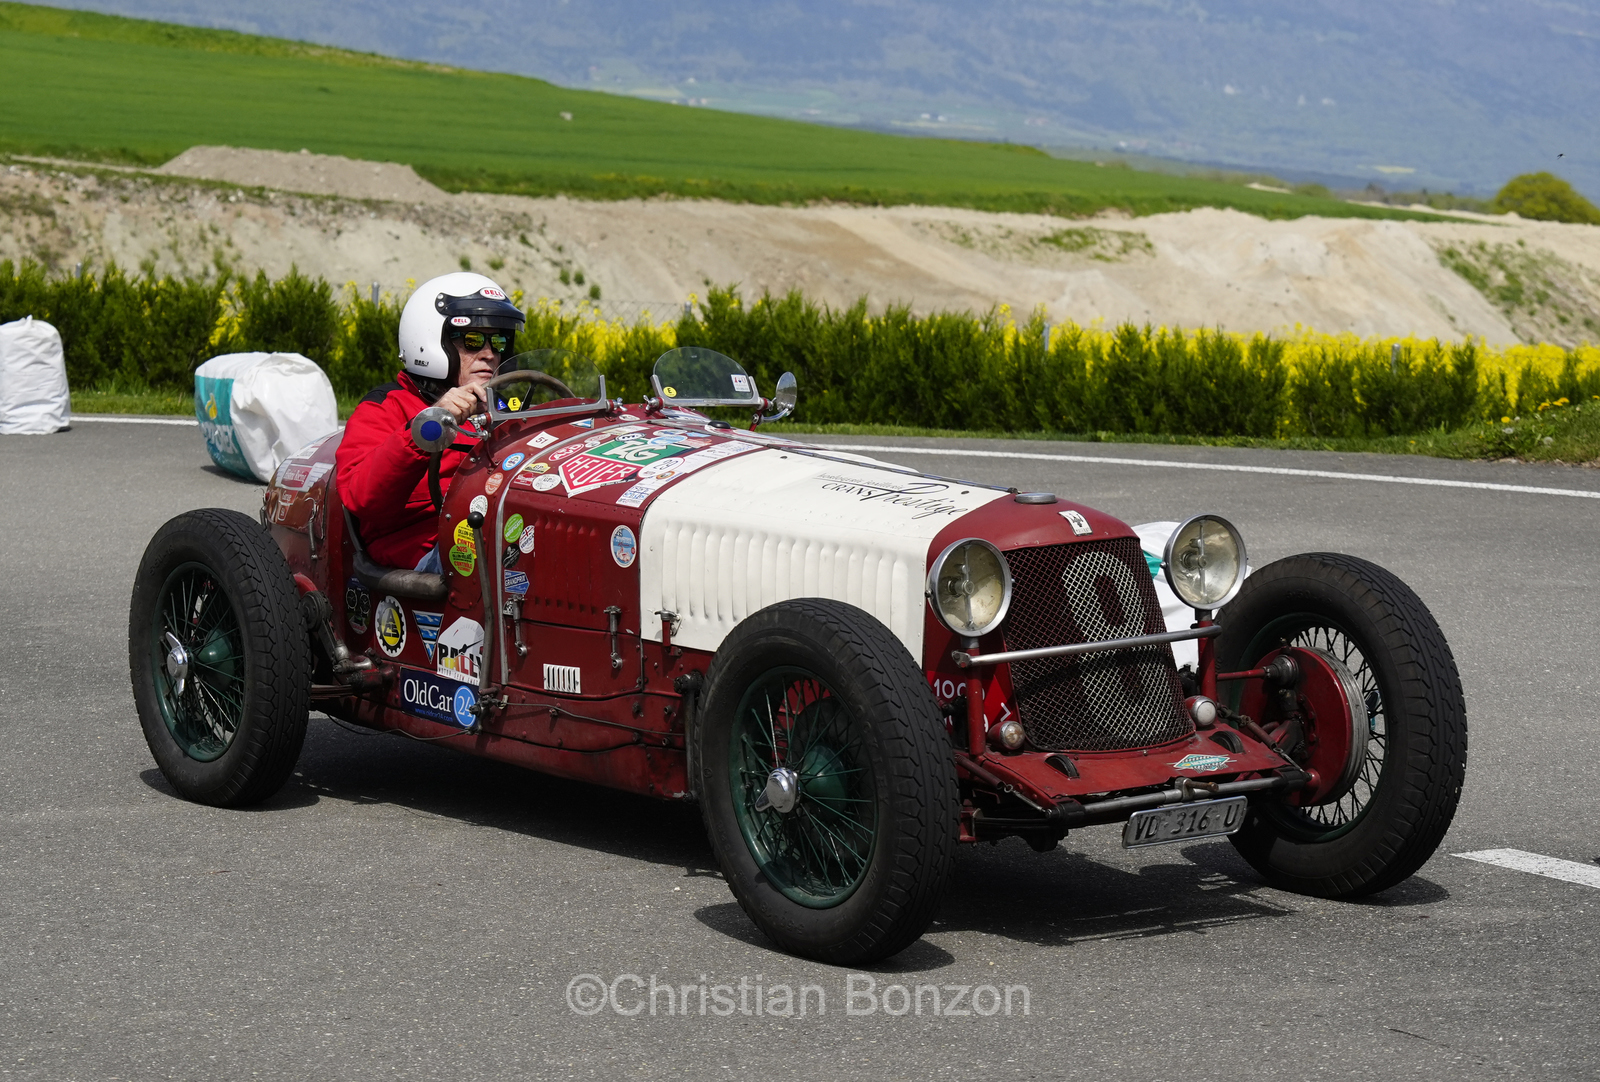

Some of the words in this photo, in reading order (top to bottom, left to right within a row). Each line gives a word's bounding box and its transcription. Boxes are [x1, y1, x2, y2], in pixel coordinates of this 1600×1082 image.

[484, 289, 504, 297] BELL
[565, 456, 637, 486] HEUER
[821, 482, 878, 498] CRANS
[404, 678, 453, 713] OldCar
[458, 695, 473, 718] 24
[1134, 814, 1160, 841] VD
[1170, 806, 1212, 835] 316
[1223, 803, 1240, 828] U
